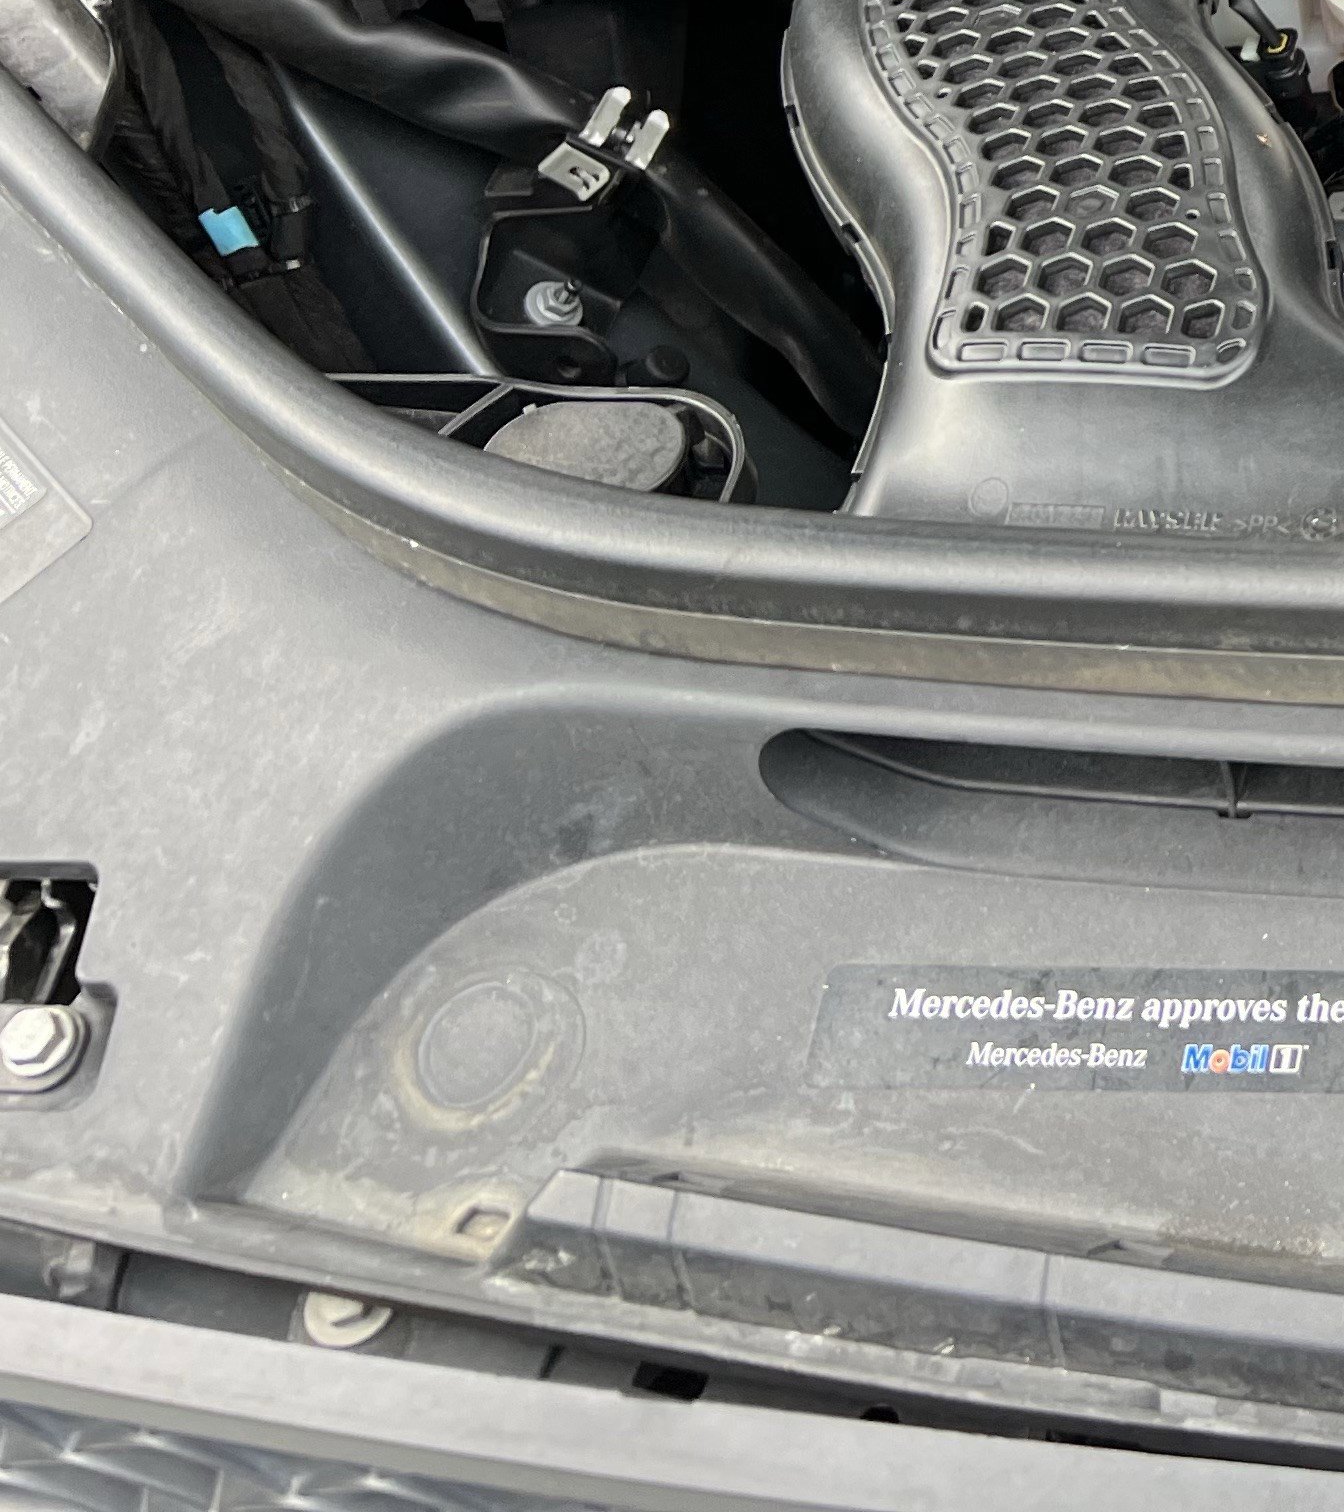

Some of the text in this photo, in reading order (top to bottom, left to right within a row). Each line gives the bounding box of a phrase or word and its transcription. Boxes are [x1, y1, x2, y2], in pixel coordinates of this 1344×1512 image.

[887, 987, 1134, 1023] Mercedes-Benz
[1141, 991, 1287, 1032] approves
[965, 1040, 1148, 1070] Mercedes-Benz
